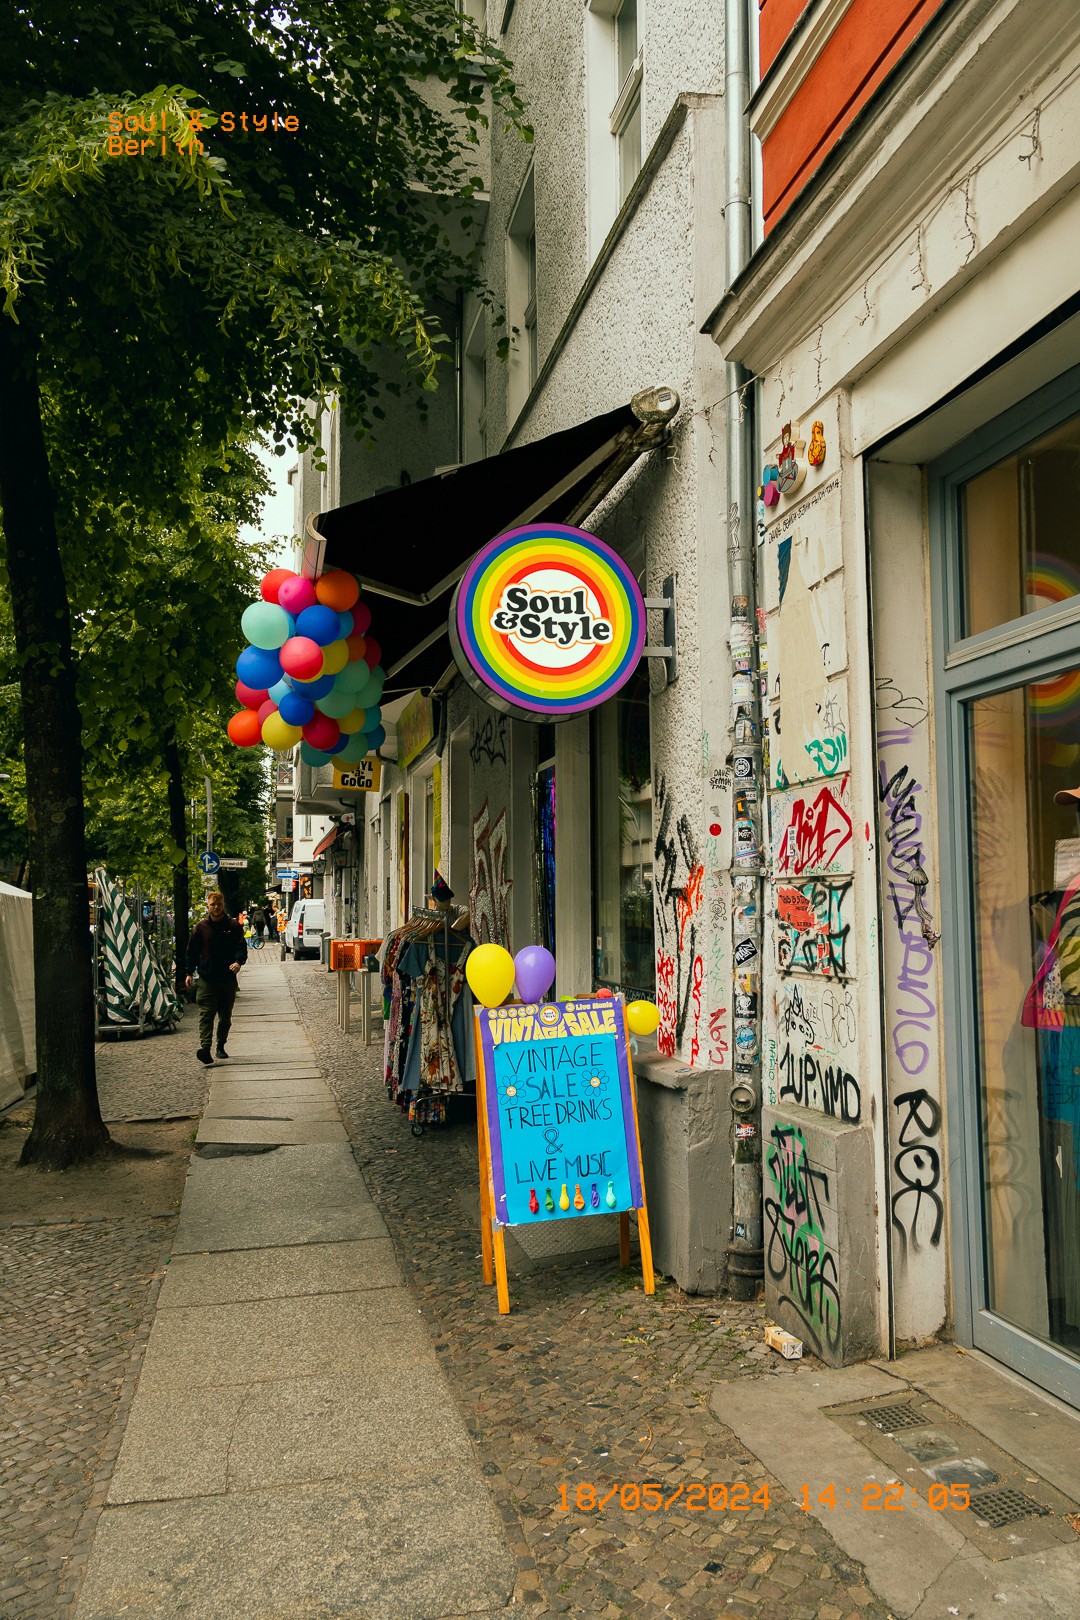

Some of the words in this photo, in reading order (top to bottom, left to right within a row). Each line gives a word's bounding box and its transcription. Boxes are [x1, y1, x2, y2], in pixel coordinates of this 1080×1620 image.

[506, 587, 586, 615] Soul
[488, 1015, 568, 1045] VINTAGE
[563, 1009, 617, 1037] SALE
[506, 1042, 604, 1074] VINTAGE
[525, 1073, 579, 1103] SALE
[505, 1103, 553, 1129] FREE
[555, 1097, 613, 1125] DRINKS
[542, 1126, 564, 1155] &
[514, 1158, 557, 1184] LIVE
[564, 1150, 612, 1179] MUSIC
